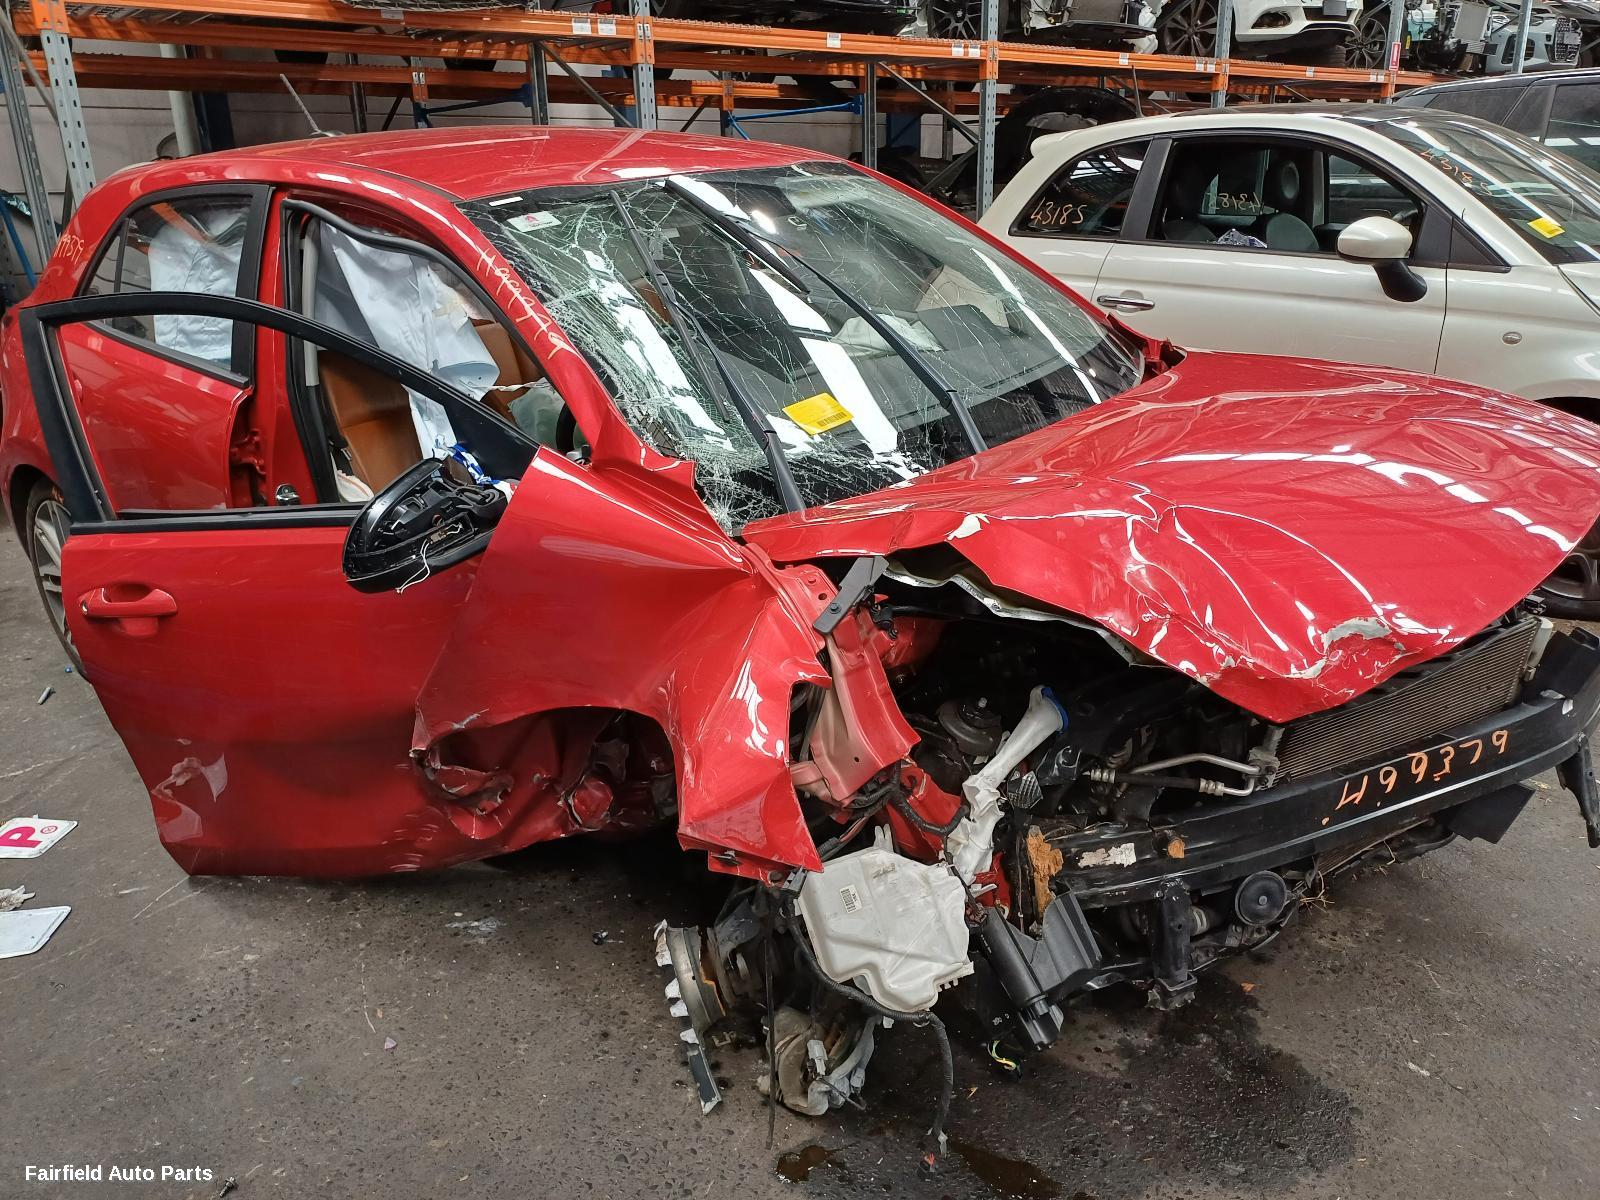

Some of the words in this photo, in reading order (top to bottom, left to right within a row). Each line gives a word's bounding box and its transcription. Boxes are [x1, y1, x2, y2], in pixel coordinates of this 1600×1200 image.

[1420, 148, 1493, 196] 43185
[1031, 197, 1088, 225] 43185
[0, 826, 43, 849] P
